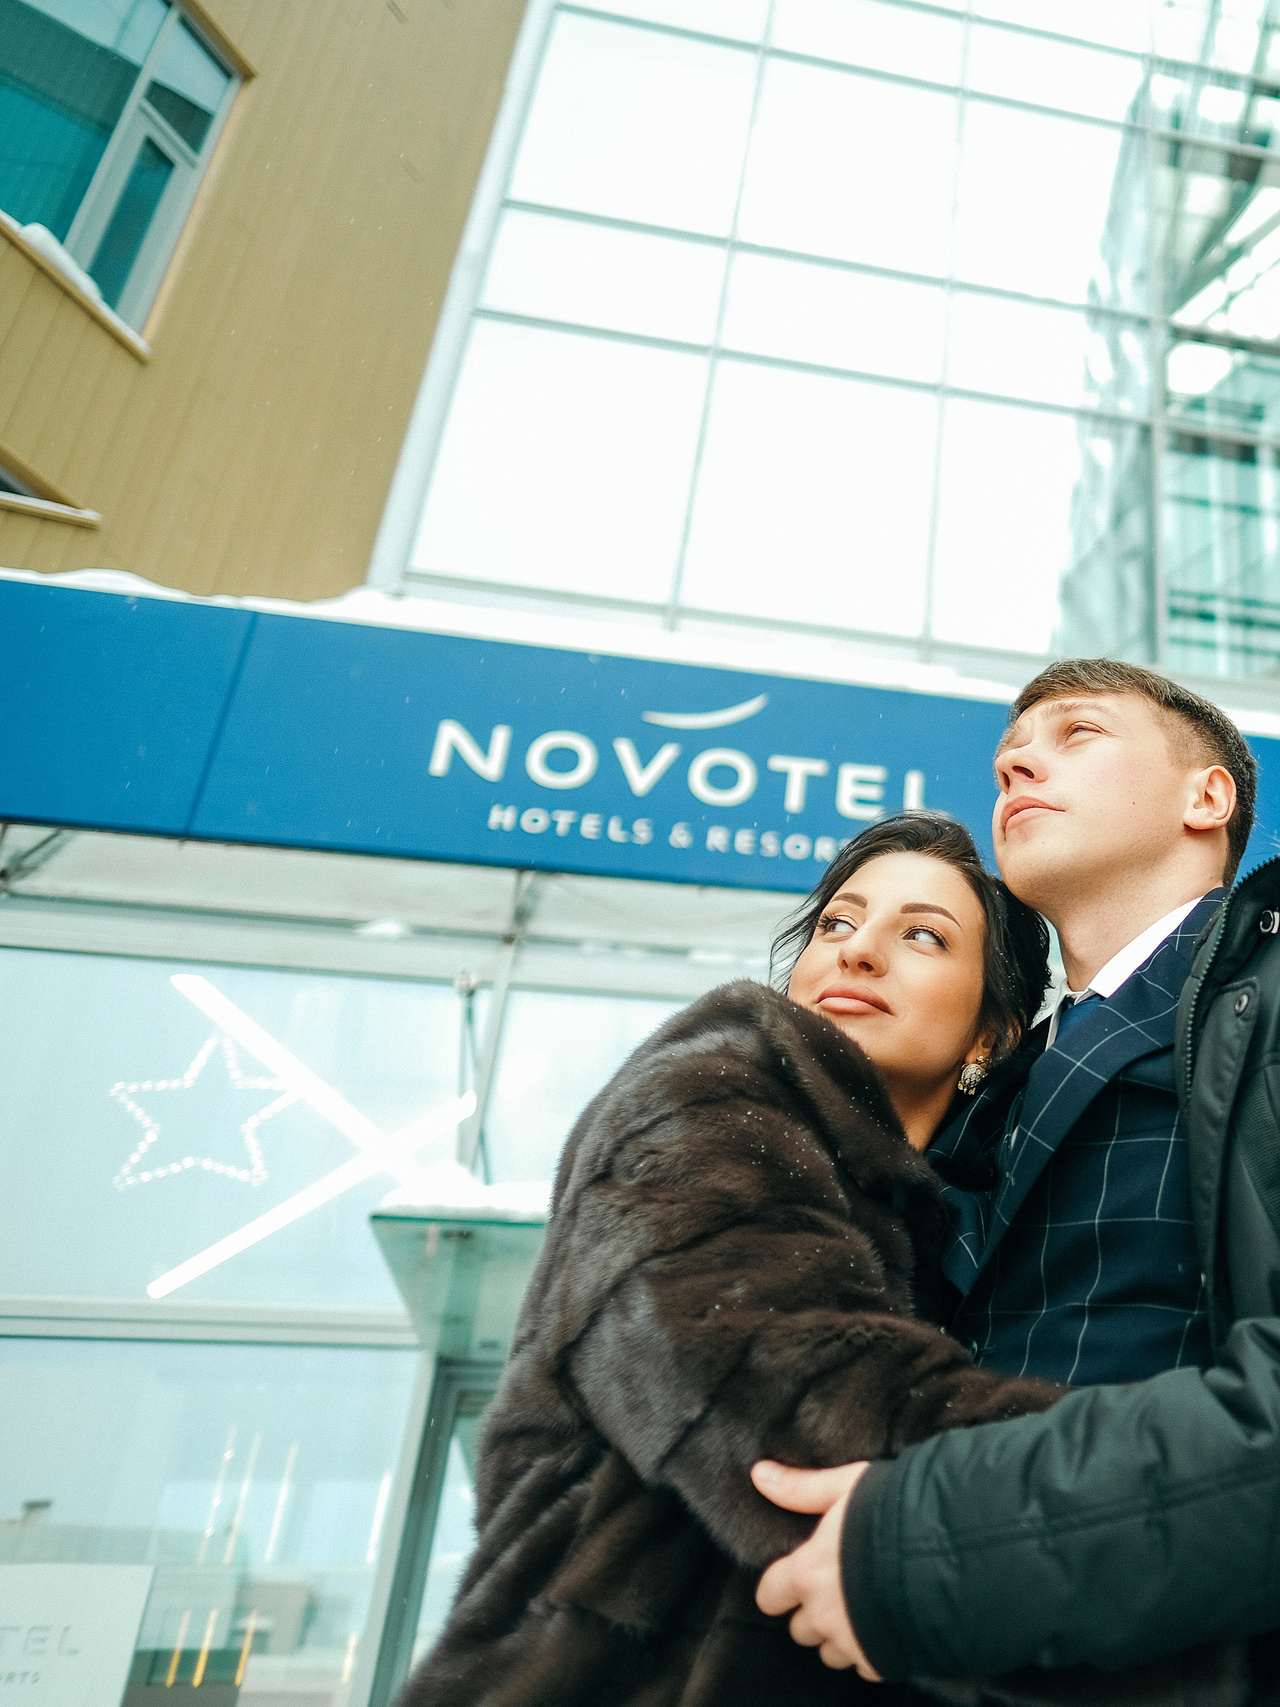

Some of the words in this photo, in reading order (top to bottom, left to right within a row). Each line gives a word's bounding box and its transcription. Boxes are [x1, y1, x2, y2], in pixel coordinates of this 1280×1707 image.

[428, 718, 950, 821] NOVOTEL
[487, 803, 653, 845] HOTELS
[668, 821, 693, 849] &
[705, 825, 852, 862] RESOR
